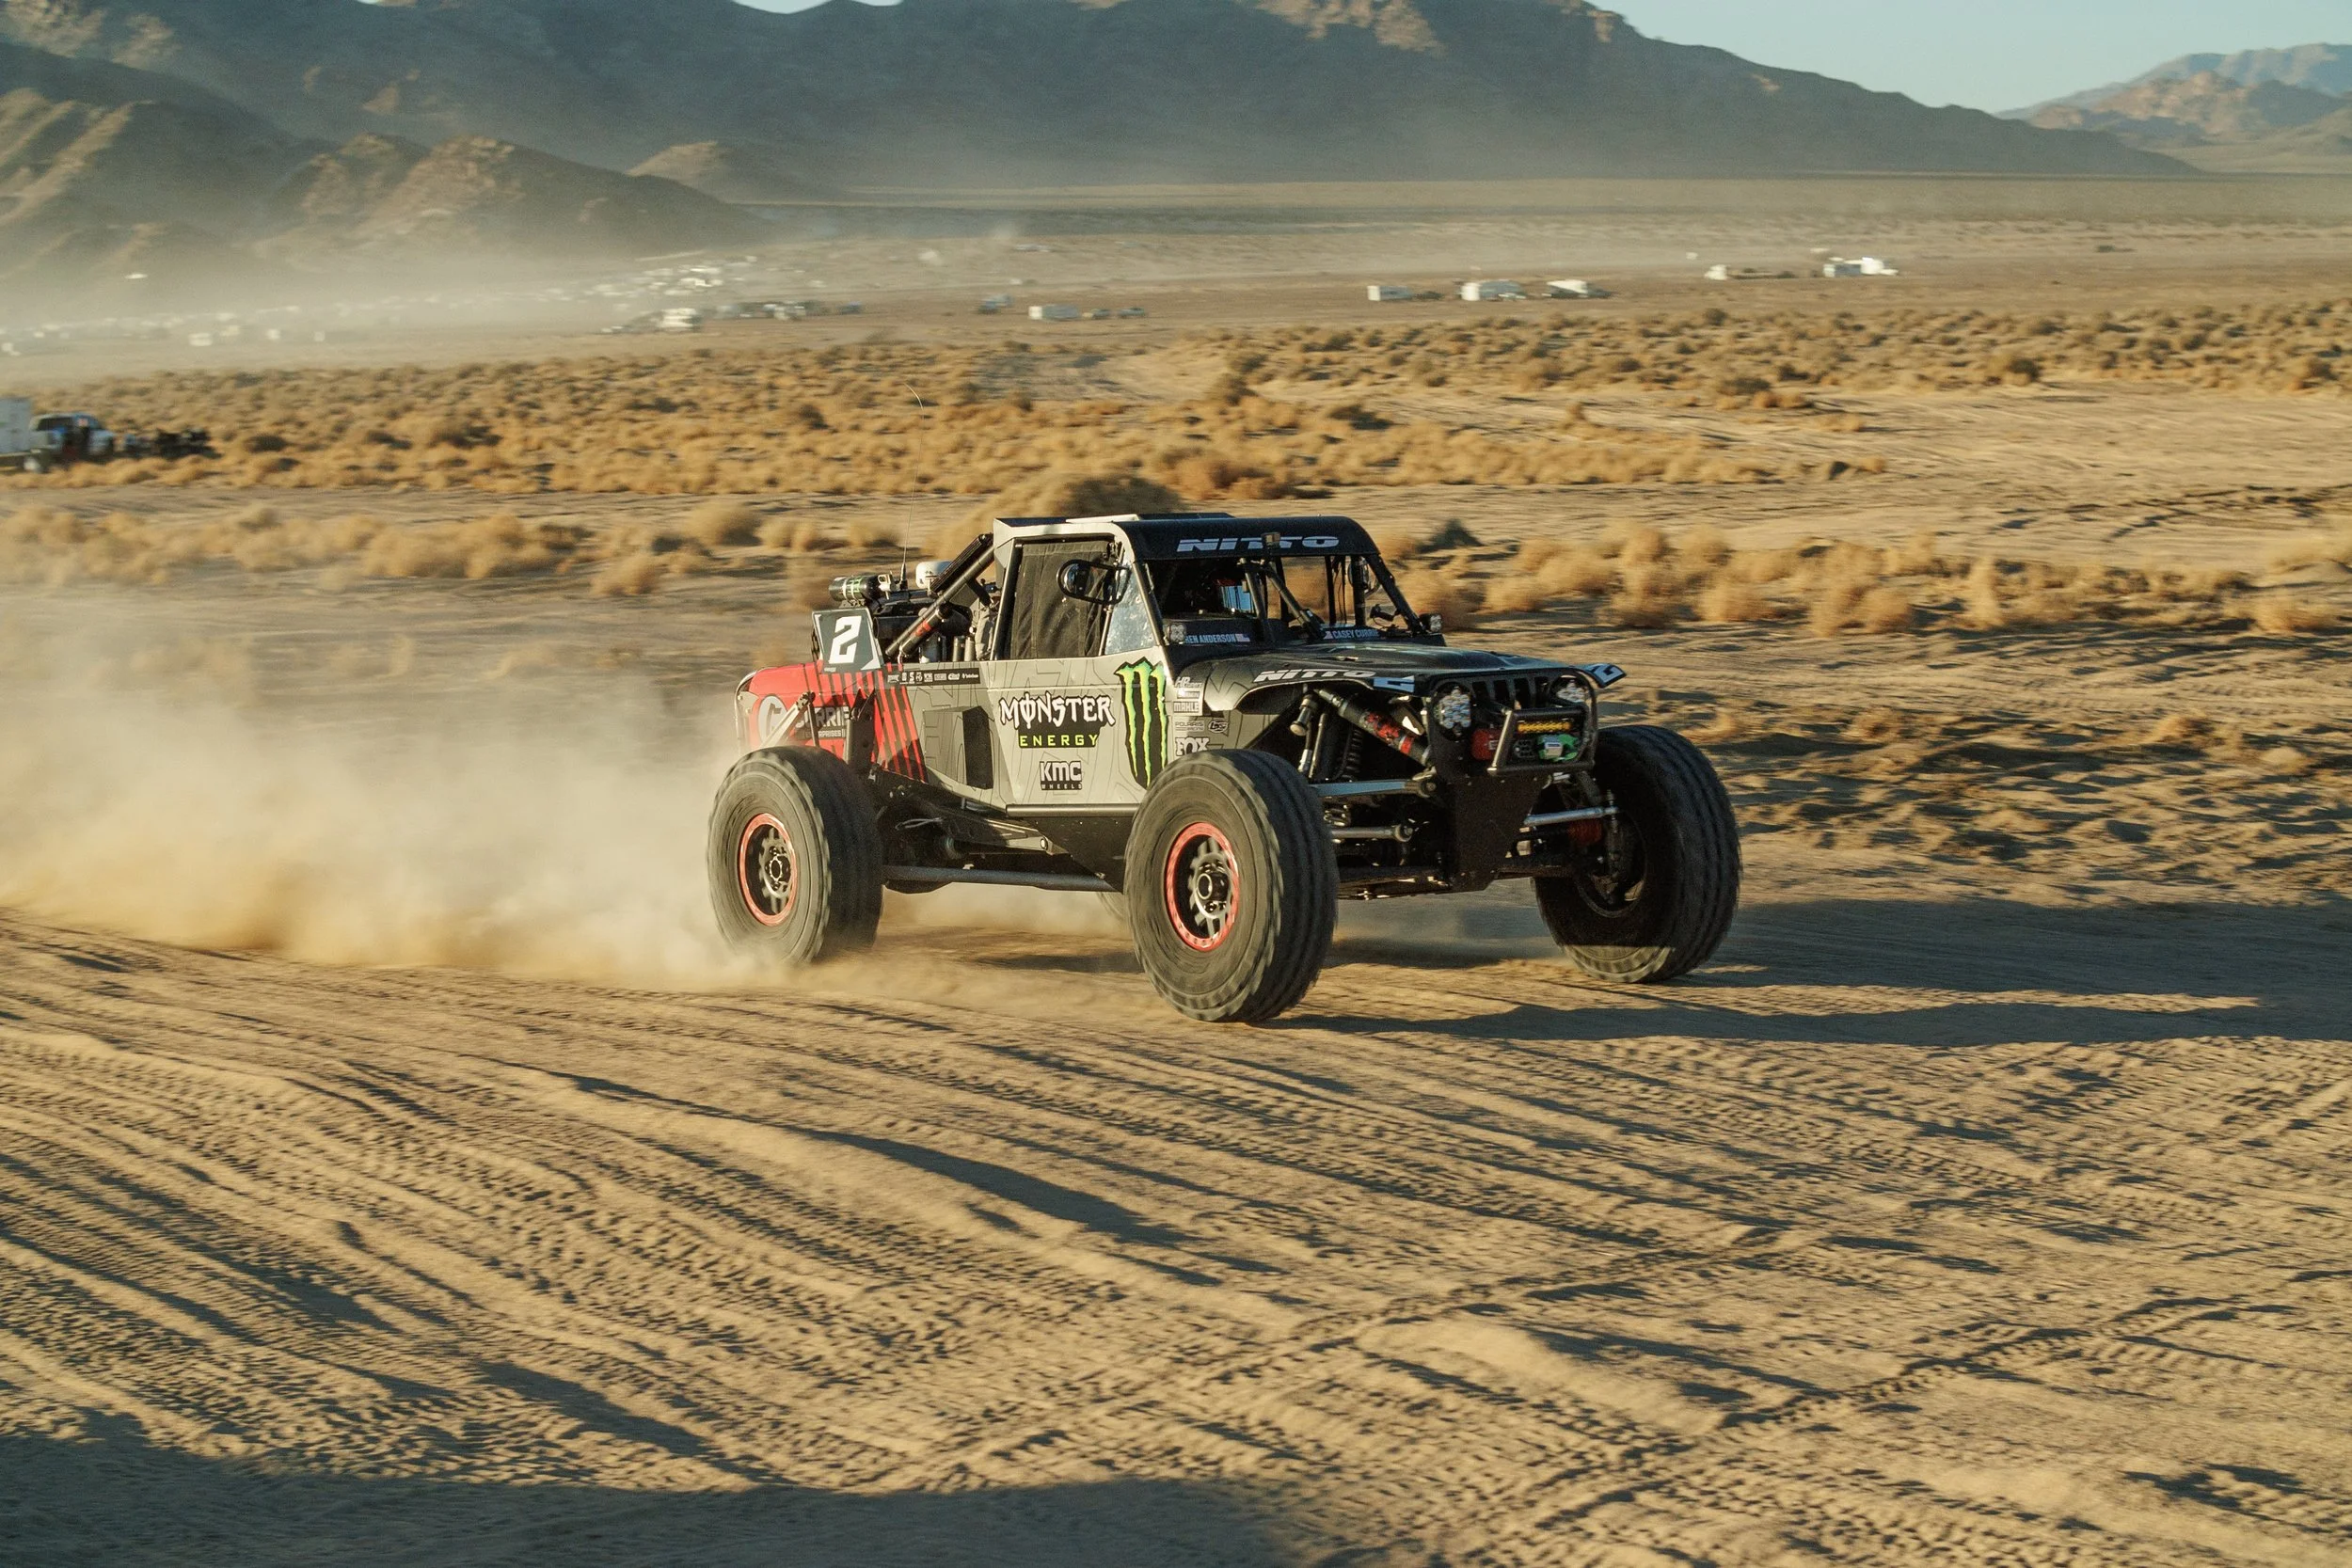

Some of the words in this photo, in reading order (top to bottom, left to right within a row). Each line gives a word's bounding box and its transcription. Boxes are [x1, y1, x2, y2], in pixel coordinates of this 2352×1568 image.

[1177, 536, 1339, 552] NITTO
[829, 616, 862, 664] 2
[1200, 634, 1235, 642] ANDERSON
[1253, 669, 1376, 683] NITTO
[1174, 702, 1200, 713] MAHLE
[1020, 735, 1098, 746] ENERGY
[1175, 736, 1209, 756] FOX
[1041, 762, 1081, 782] KMC
